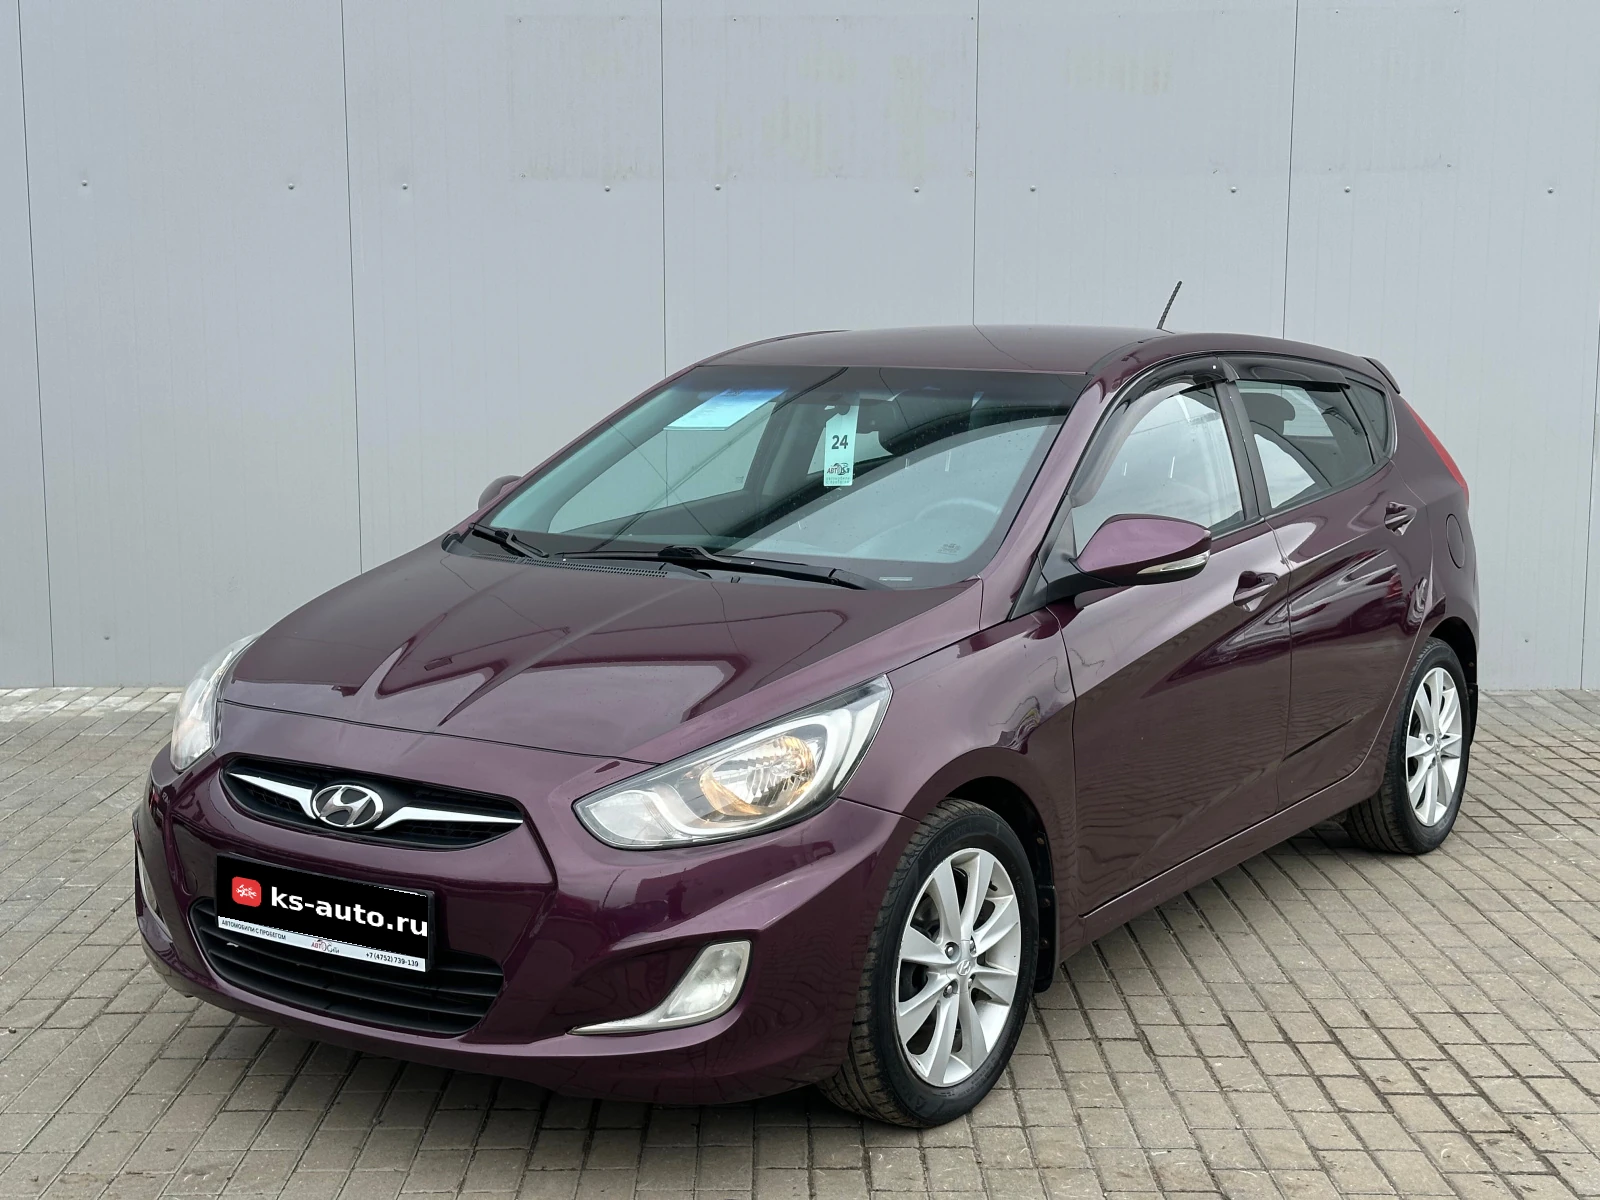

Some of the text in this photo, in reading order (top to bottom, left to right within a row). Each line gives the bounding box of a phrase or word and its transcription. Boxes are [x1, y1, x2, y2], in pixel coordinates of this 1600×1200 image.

[831, 434, 849, 450] 24
[221, 919, 256, 933] АВТОМОБИЛИ
[259, 929, 287, 940] ПРОБЕГОМ
[373, 952, 393, 963] (4752)
[394, 956, 419, 967] 739-139
